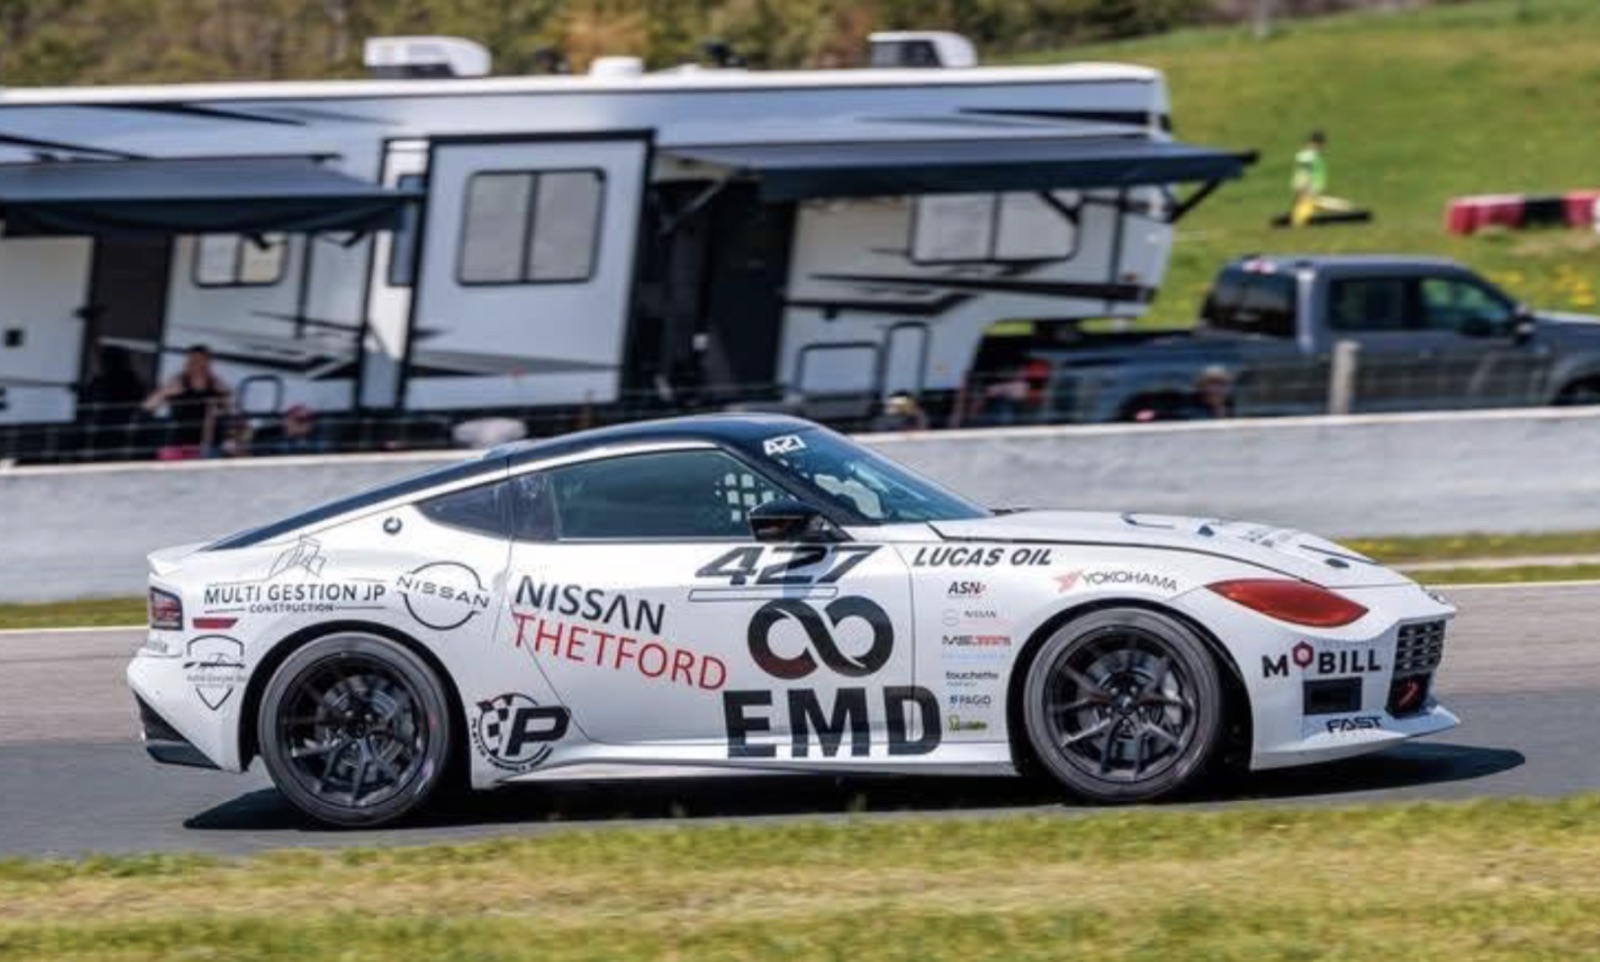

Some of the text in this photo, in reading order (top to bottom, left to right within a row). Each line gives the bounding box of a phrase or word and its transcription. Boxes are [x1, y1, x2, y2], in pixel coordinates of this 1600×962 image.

[695, 545, 883, 585] 427
[913, 547, 1053, 567] LUCAS OIL
[204, 583, 387, 604] MULTI GESTION JP
[397, 574, 490, 609] NISSAN
[1082, 570, 1178, 591] YOKOHAMA
[250, 602, 335, 614] CONSTRUCTION
[515, 574, 666, 635] NISSAN
[512, 612, 727, 691] THETFORD
[723, 685, 942, 759] EMD
[1326, 716, 1383, 734] FAST
